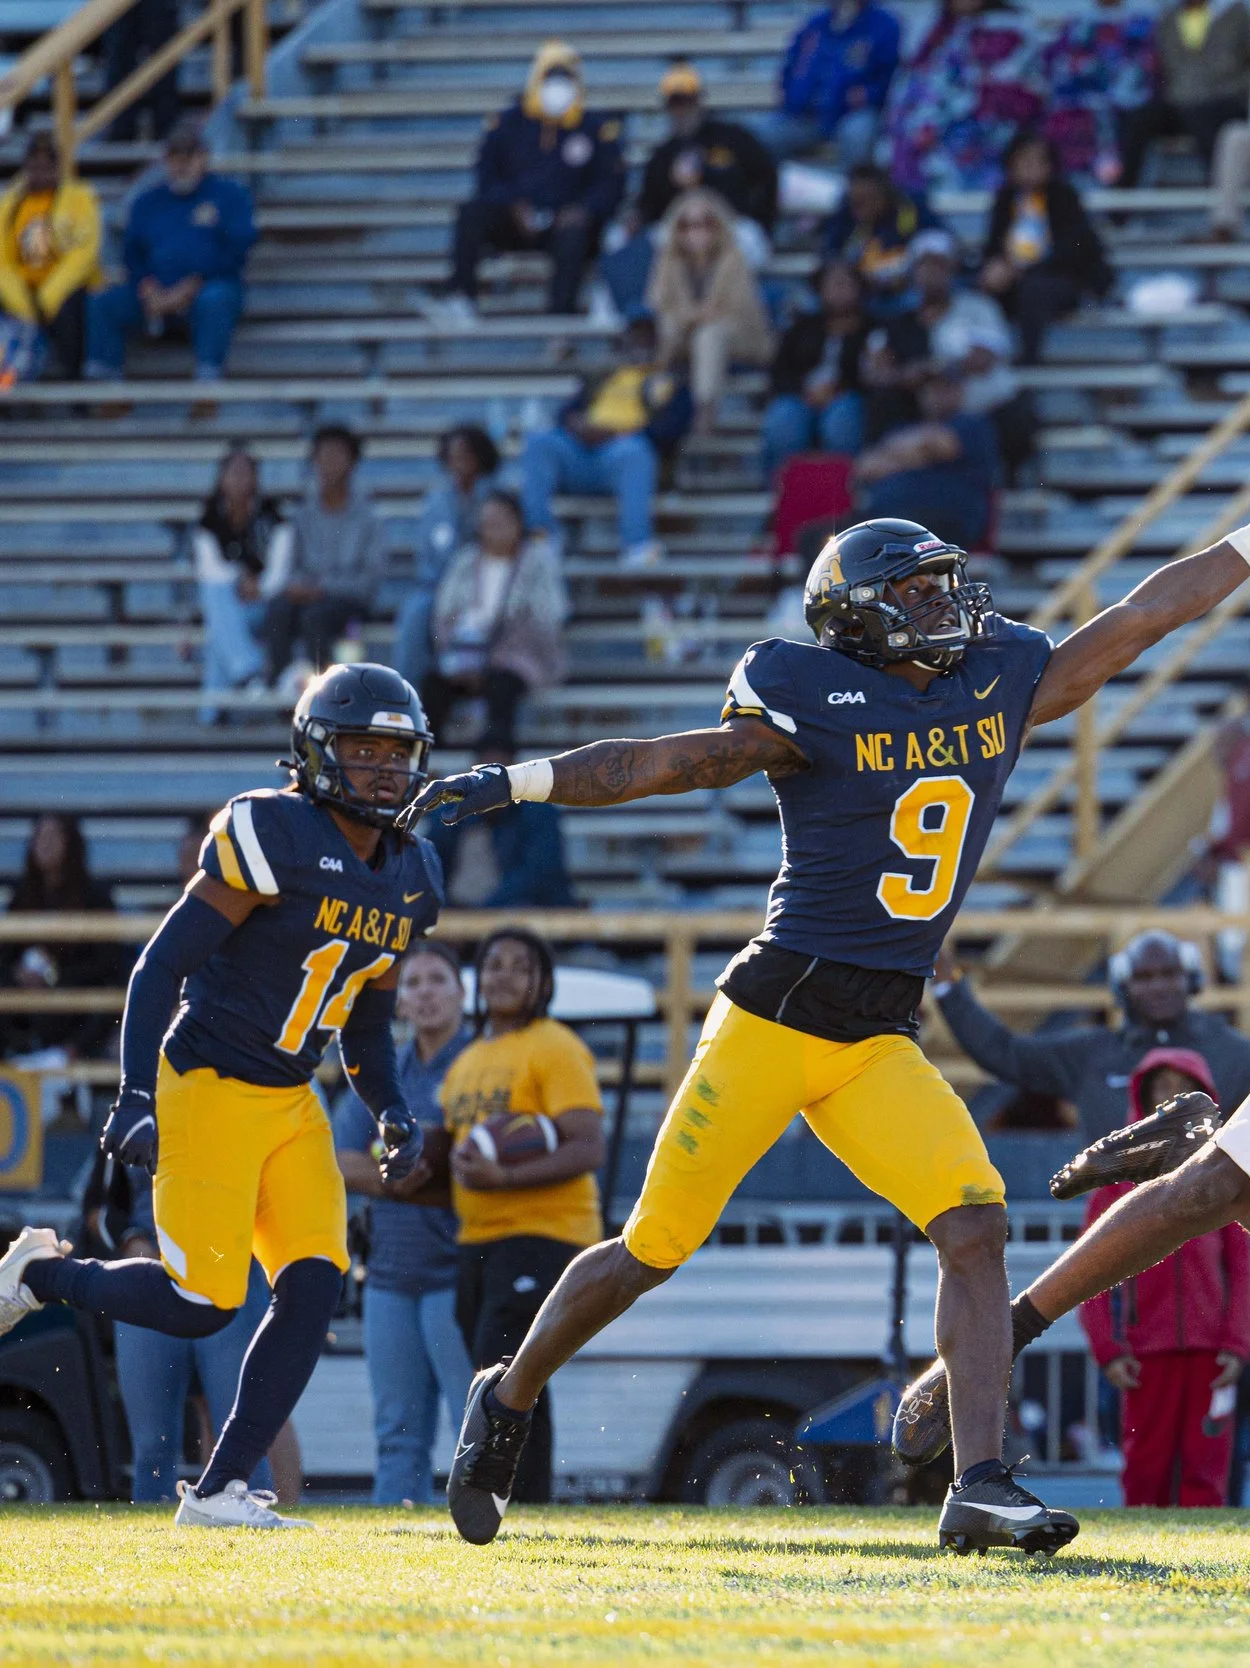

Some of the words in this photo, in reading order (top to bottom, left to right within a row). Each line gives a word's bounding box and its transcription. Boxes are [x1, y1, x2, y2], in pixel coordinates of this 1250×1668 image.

[828, 691, 866, 704] CAA
[855, 733, 894, 771] NC
[906, 724, 969, 770] A&T
[976, 712, 1006, 759] SU
[319, 856, 344, 872] CAA
[876, 775, 975, 921] 9
[314, 896, 348, 935] NC
[346, 905, 395, 947] A&T
[274, 938, 396, 1056] 14
